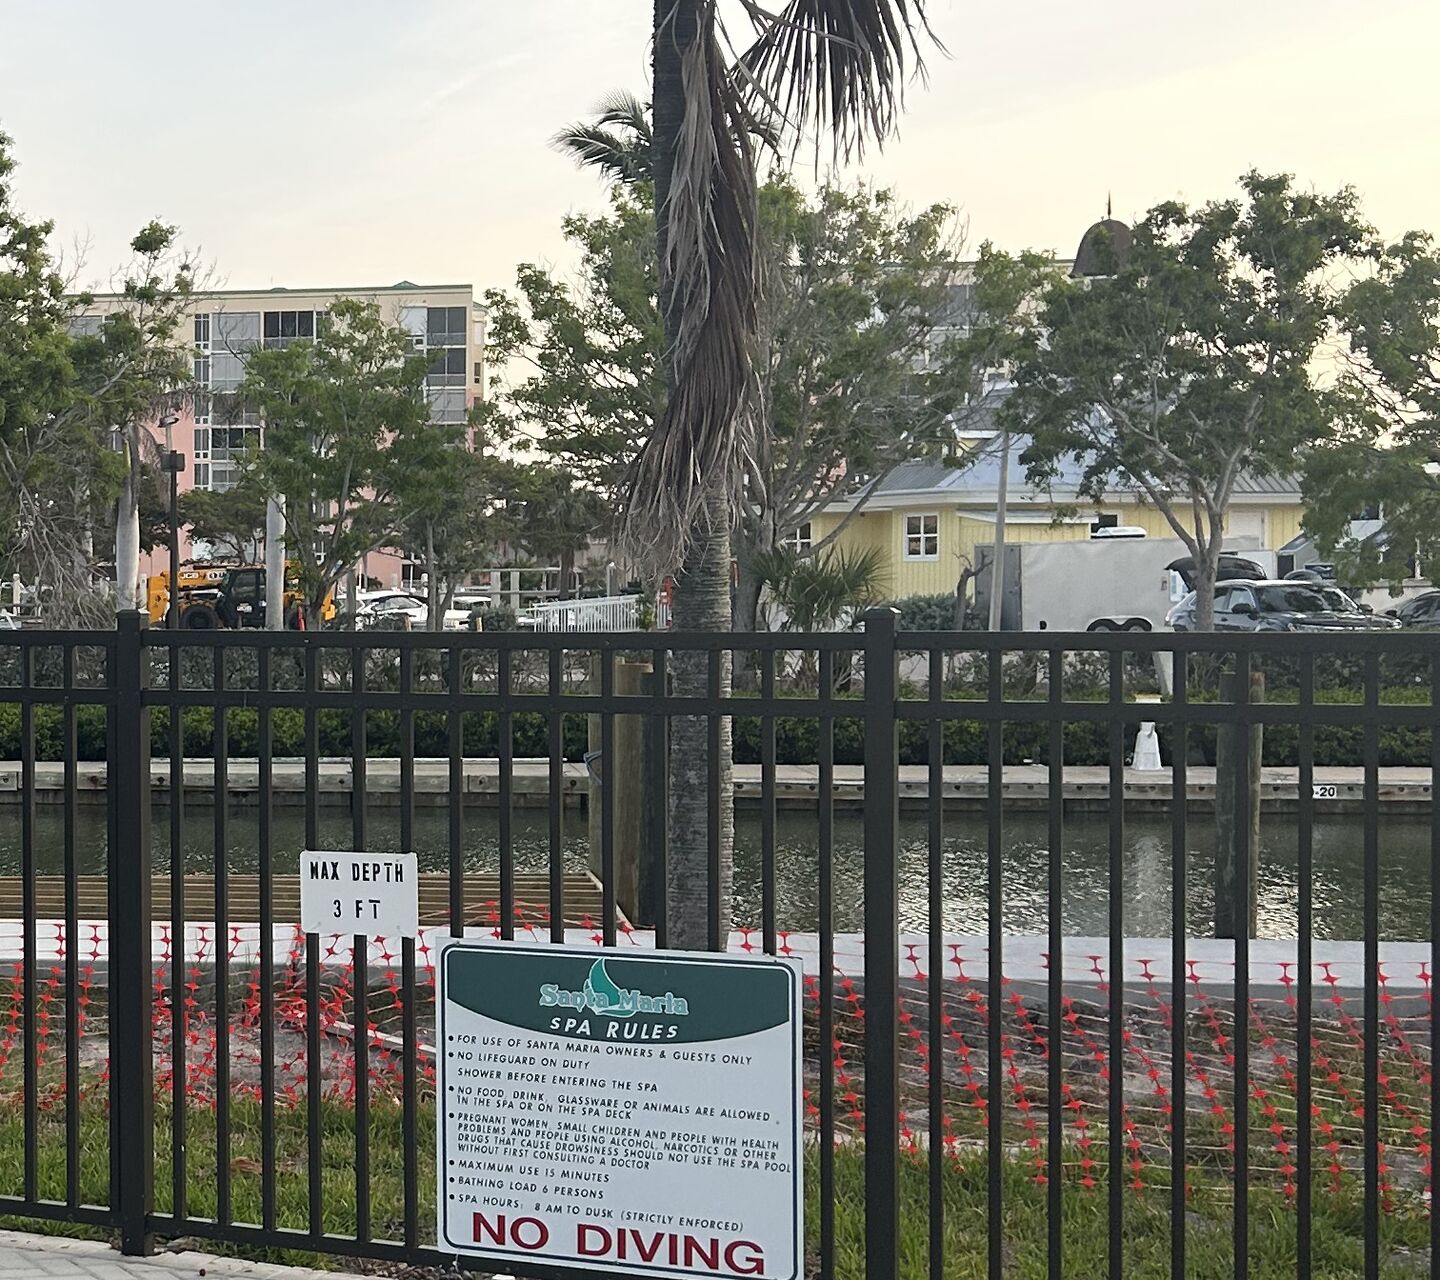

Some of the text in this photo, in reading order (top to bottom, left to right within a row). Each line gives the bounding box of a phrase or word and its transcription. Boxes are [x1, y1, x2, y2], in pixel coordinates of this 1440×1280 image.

[310, 861, 404, 883] MAX DEPTH
[333, 900, 342, 919] 3
[539, 984, 690, 1016] Santa Maria
[550, 1017, 679, 1040] SPA RULES
[457, 1035, 753, 1065] FOR USE OF SANTA MARIA OWNERS & GUESTS ONLY
[458, 1051, 591, 1069] NO LIFEGUARD ON DUTY
[458, 1068, 659, 1092] SHOWER BEFORE ENTERING THE SPA
[457, 1095, 632, 1119] IN THE SPA OR ON THE SPA DECK
[458, 1086, 473, 1095] NO
[558, 1095, 619, 1108] GLASSWARE
[624, 1101, 639, 1110] OR
[643, 1102, 691, 1114] ANIMALS
[695, 1107, 715, 1116] ARE
[720, 1109, 771, 1121] ALLOWED
[458, 1112, 507, 1125] PREGNANT
[557, 1122, 588, 1132] SMALL
[592, 1125, 641, 1137] CHILDREN
[645, 1130, 667, 1139] AND
[671, 1132, 707, 1143] PEOPLE
[712, 1136, 737, 1146] WITH
[742, 1139, 779, 1150] HEALTH
[458, 1123, 507, 1135] PROBLEMS
[511, 1128, 531, 1137] AND
[536, 1130, 570, 1141] PEOPLE
[574, 1133, 606, 1144] USING
[664, 1142, 719, 1155] NARCOTICS
[724, 1148, 738, 1157] OR
[743, 1149, 777, 1160] OTHER
[458, 1133, 792, 1173] DRUGS THAT CAUSE DROWSINESS SHOULD NOT USE THE SPA POOL
[458, 1143, 650, 1170] WITHOUT FIRST CONSULTING A DOCTOR
[459, 1160, 610, 1182] MAXIMUM USE 15 MINUTES
[459, 1176, 605, 1199] BATHING LOAD 6 PERSONS
[459, 1194, 478, 1204] SPA
[535, 1203, 541, 1211] 8
[546, 1204, 563, 1213] AM
[567, 1205, 581, 1214] TO
[586, 1207, 614, 1218] DUSK
[621, 1211, 674, 1224] (STRICTLY
[679, 1217, 745, 1232] ENFORCED)
[472, 1211, 766, 1276] NO DIVING
